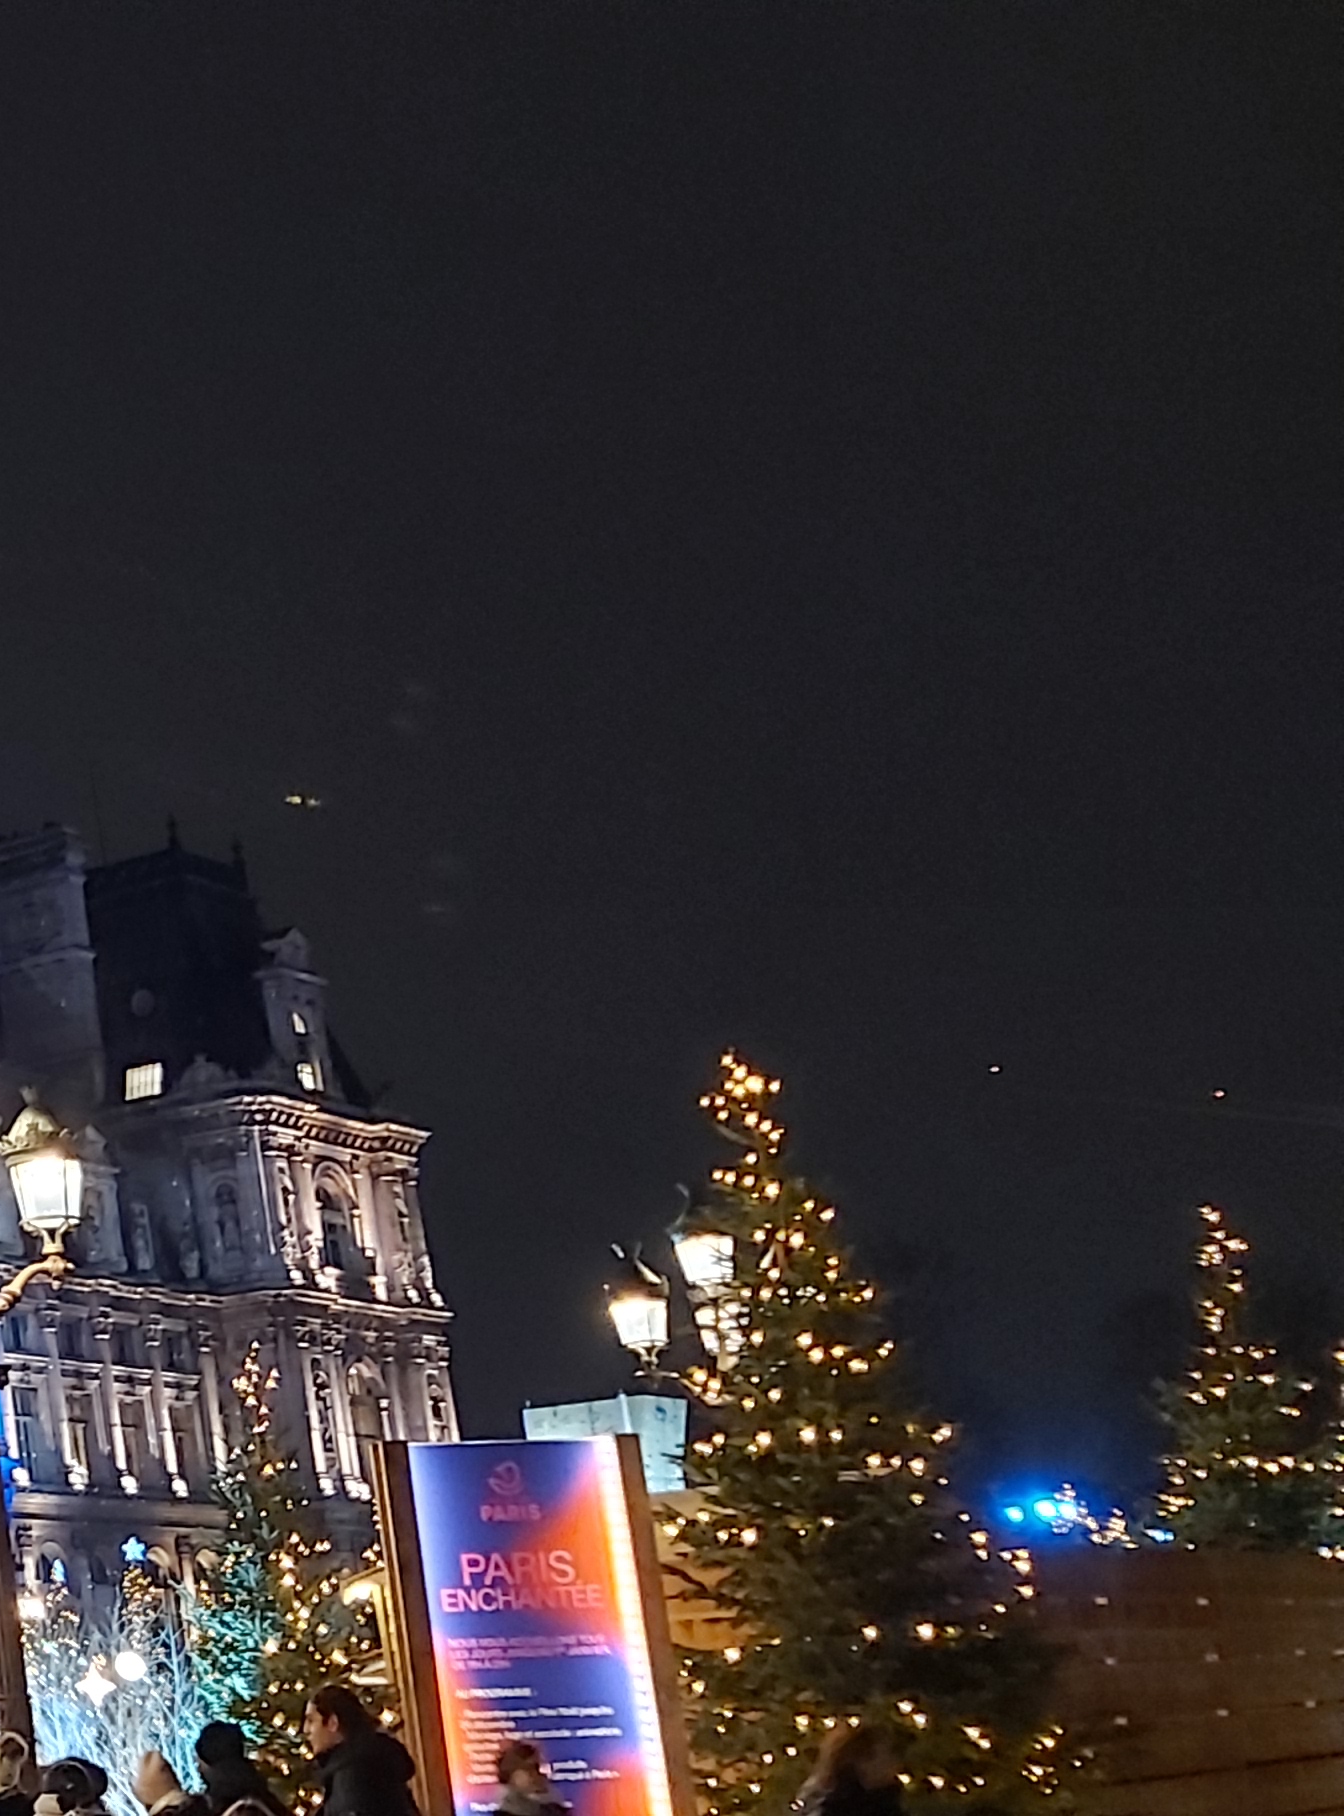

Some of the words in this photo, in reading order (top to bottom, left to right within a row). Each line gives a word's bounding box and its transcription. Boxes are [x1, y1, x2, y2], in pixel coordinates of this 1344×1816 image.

[479, 1503, 541, 1523] PARIS
[460, 1550, 577, 1586] PARIS
[440, 1581, 605, 1613] ENCHANTÉE
